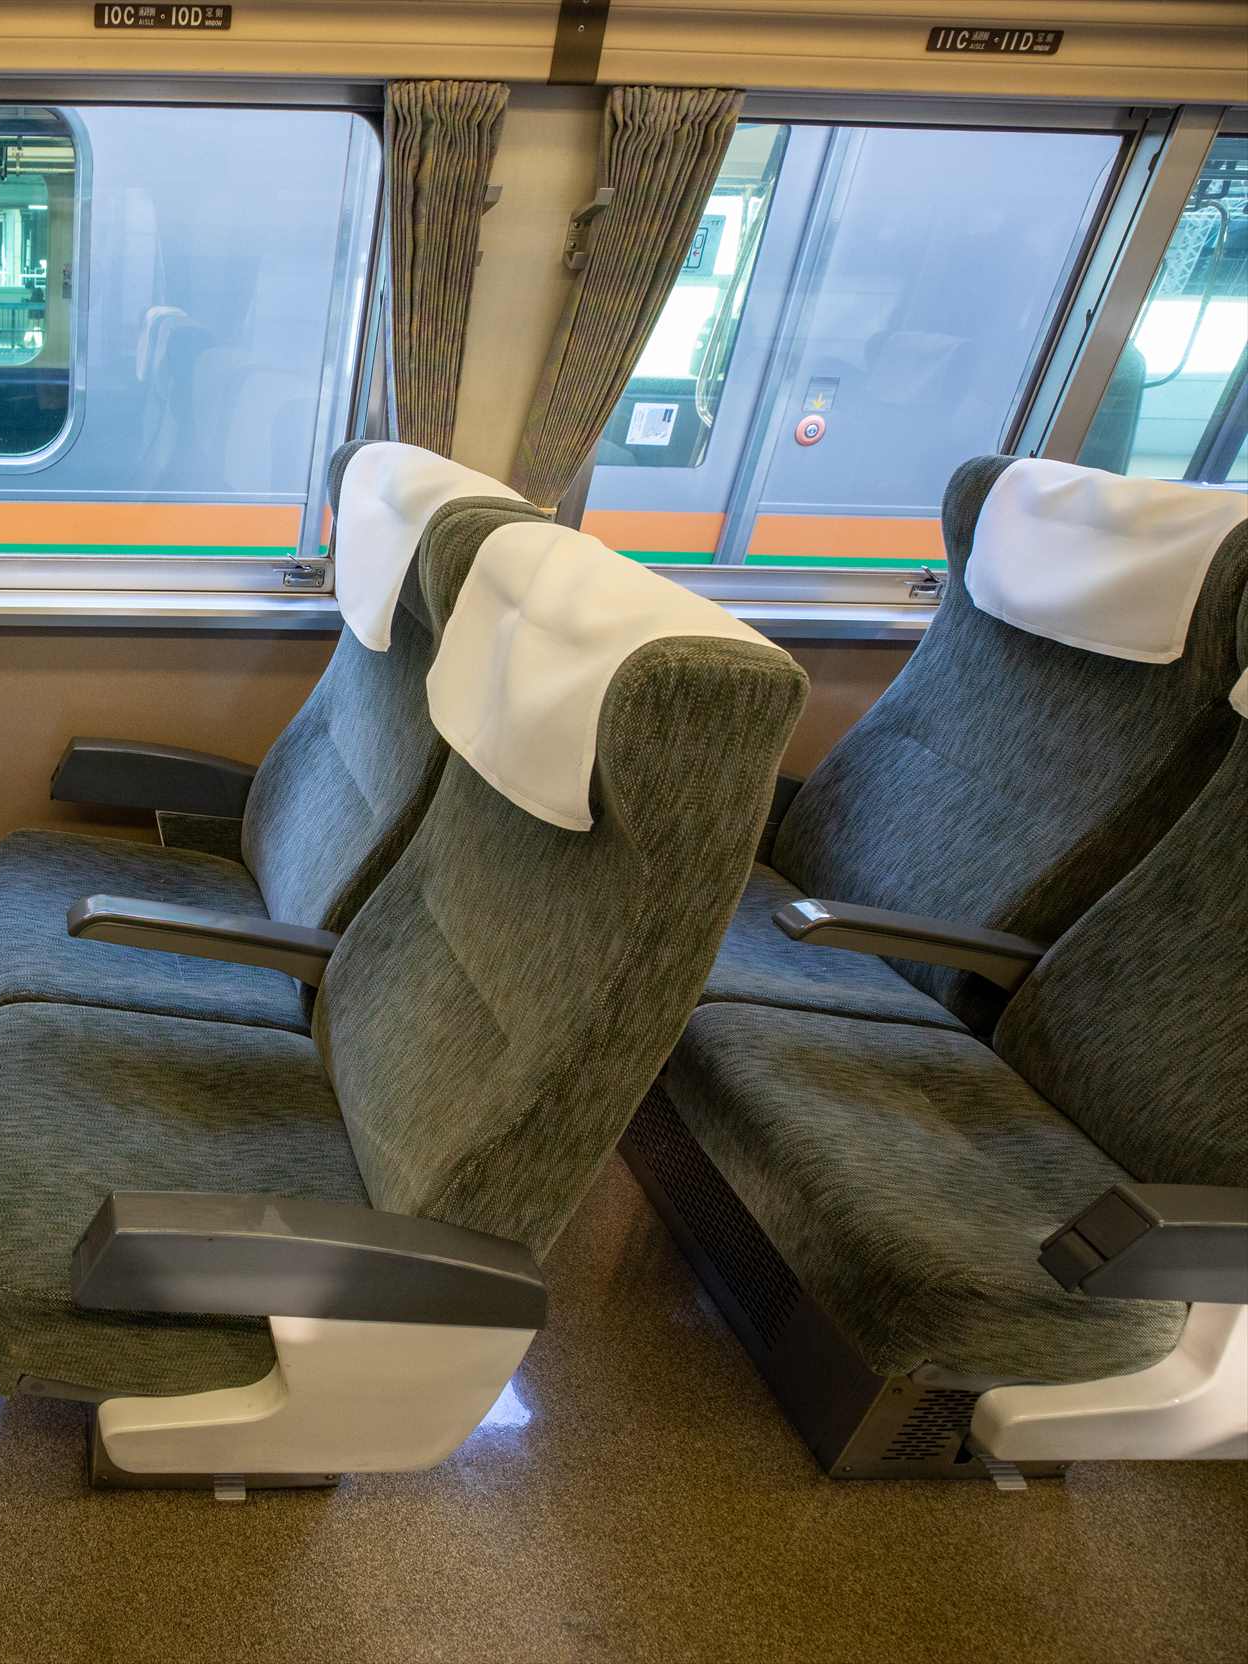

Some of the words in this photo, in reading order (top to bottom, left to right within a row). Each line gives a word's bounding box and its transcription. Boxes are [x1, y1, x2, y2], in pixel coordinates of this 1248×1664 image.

[104, 6, 135, 25] 10C
[172, 6, 202, 26] 10D
[936, 30, 969, 49] 11C
[1000, 31, 1033, 50] 11D
